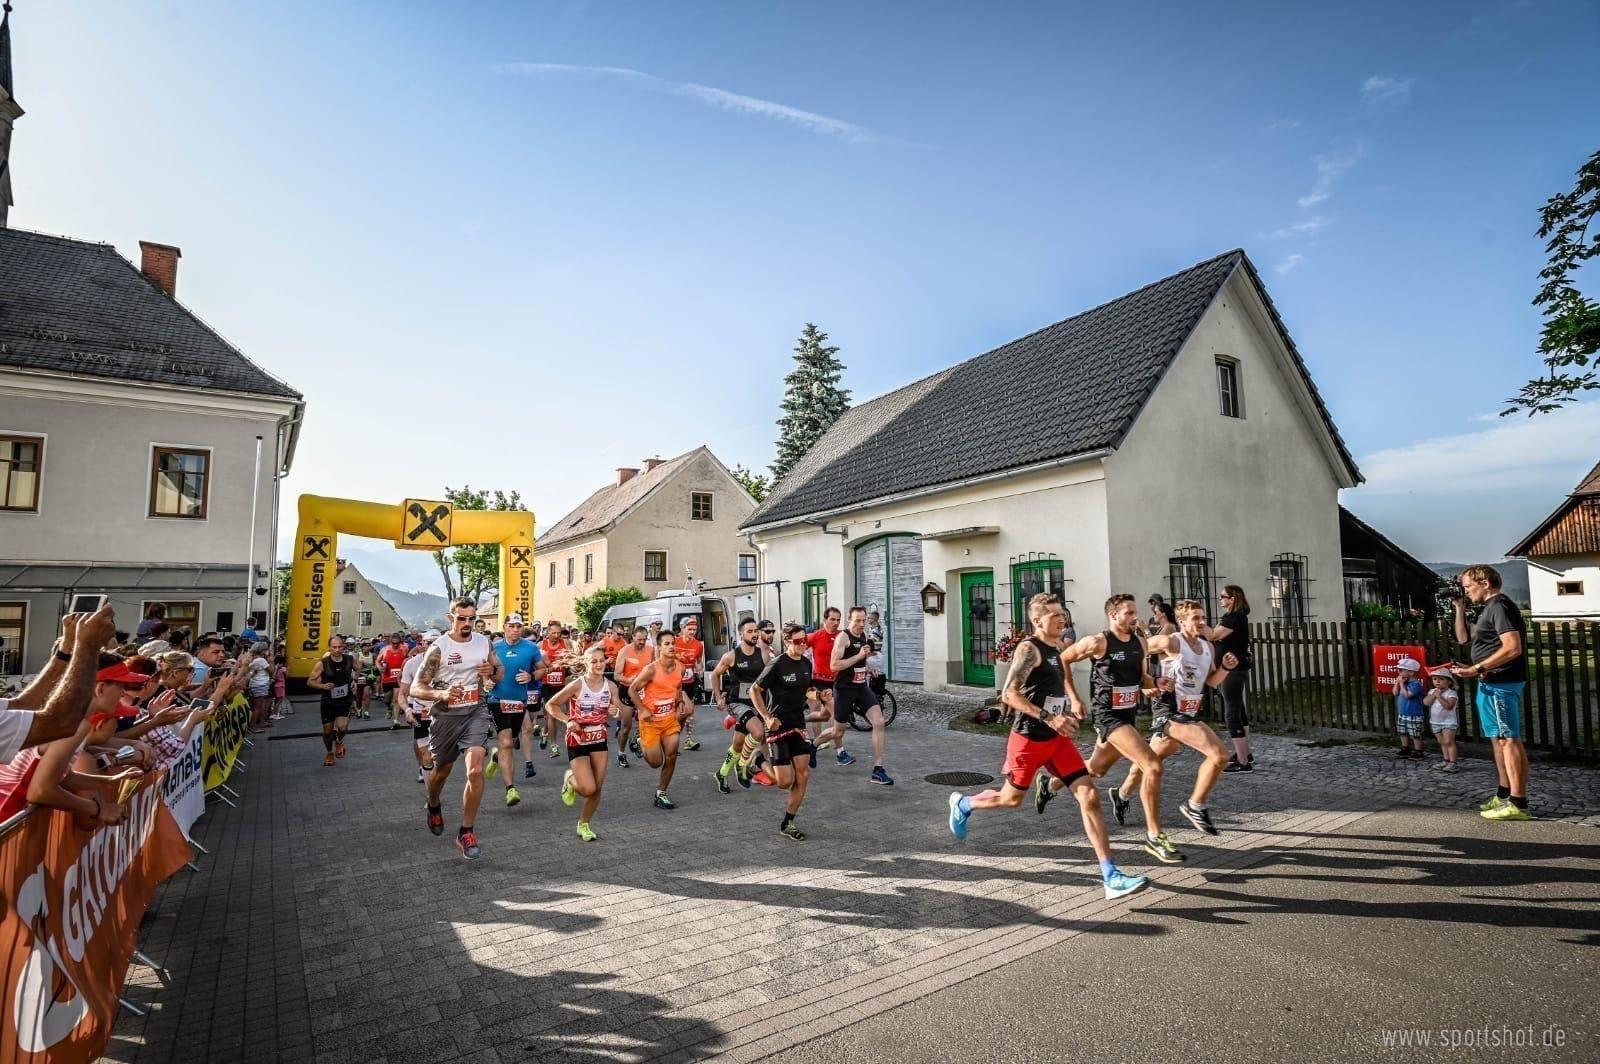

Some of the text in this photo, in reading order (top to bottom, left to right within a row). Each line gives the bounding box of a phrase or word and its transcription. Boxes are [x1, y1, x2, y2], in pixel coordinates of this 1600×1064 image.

[302, 562, 325, 652] Raiffeisen
[515, 570, 529, 626] iffeisen
[586, 730, 602, 742] 376
